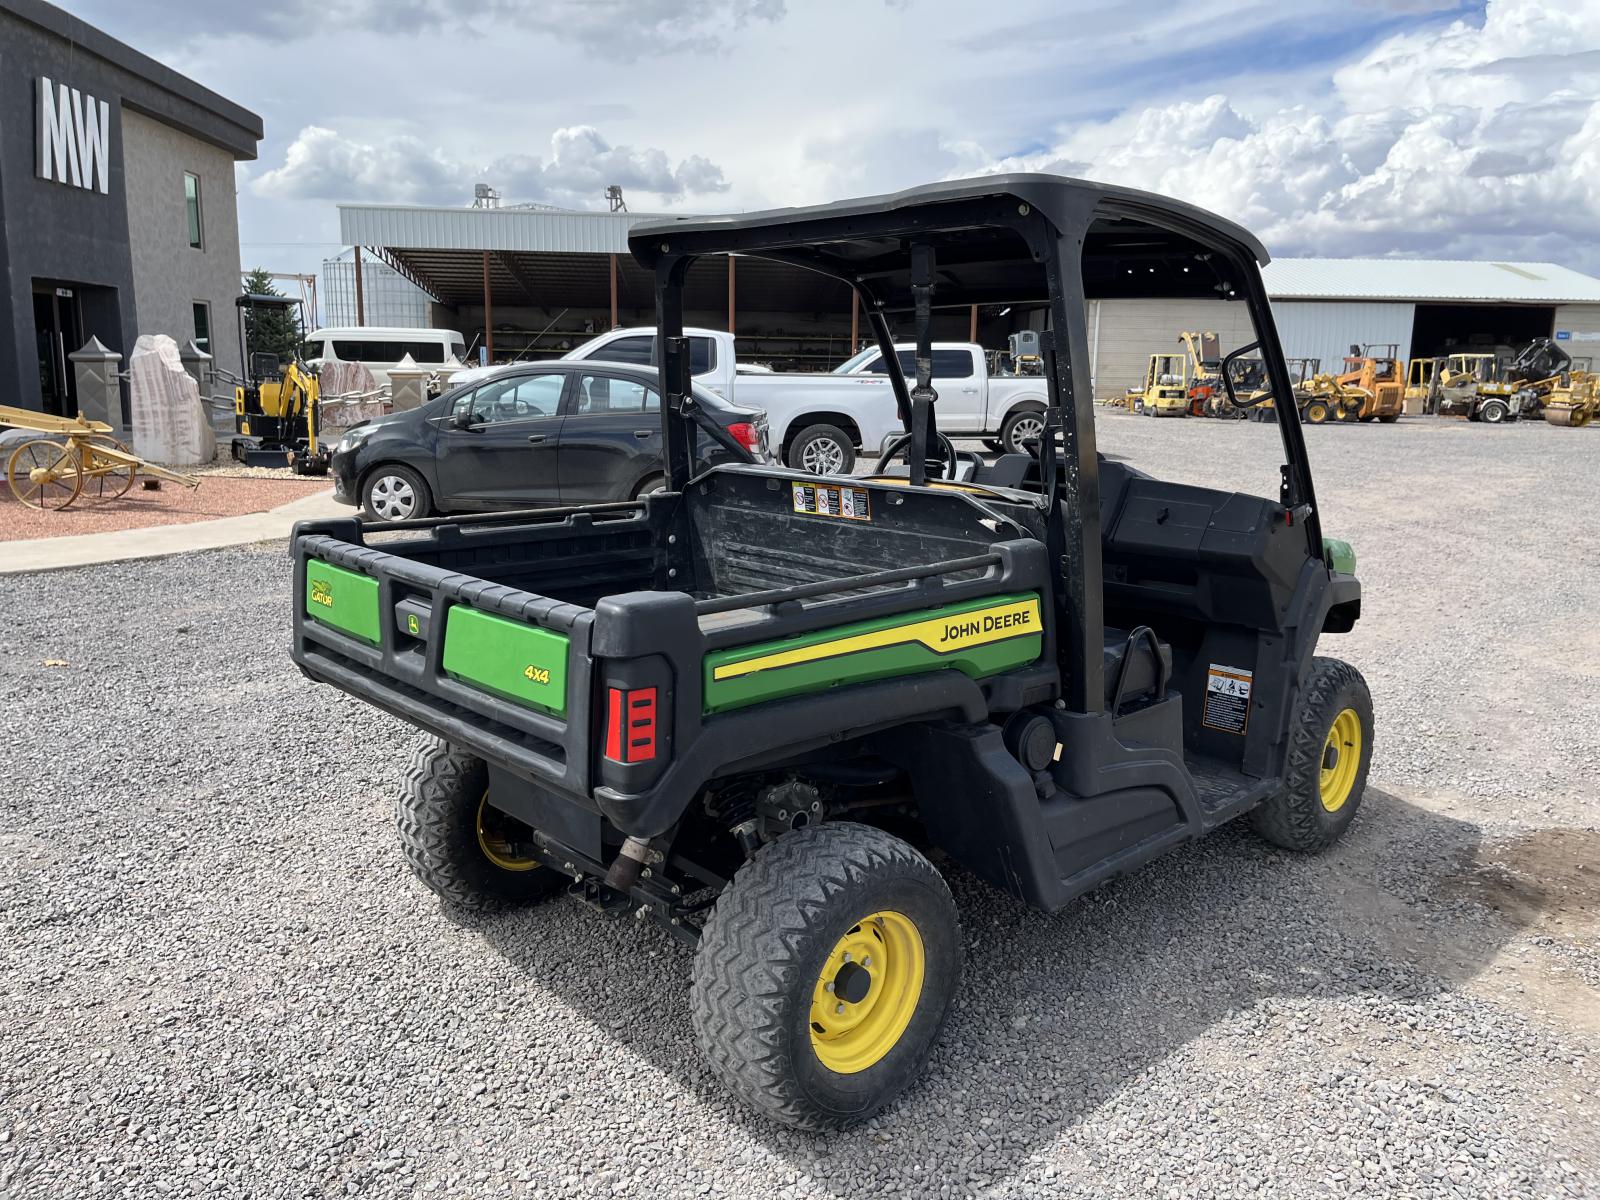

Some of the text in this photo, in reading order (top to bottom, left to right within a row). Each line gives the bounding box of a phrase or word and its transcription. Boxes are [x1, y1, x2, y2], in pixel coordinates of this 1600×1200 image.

[38, 76, 109, 195] MW
[311, 589, 333, 607] GATOR
[940, 610, 1030, 643] JOHN DEERE
